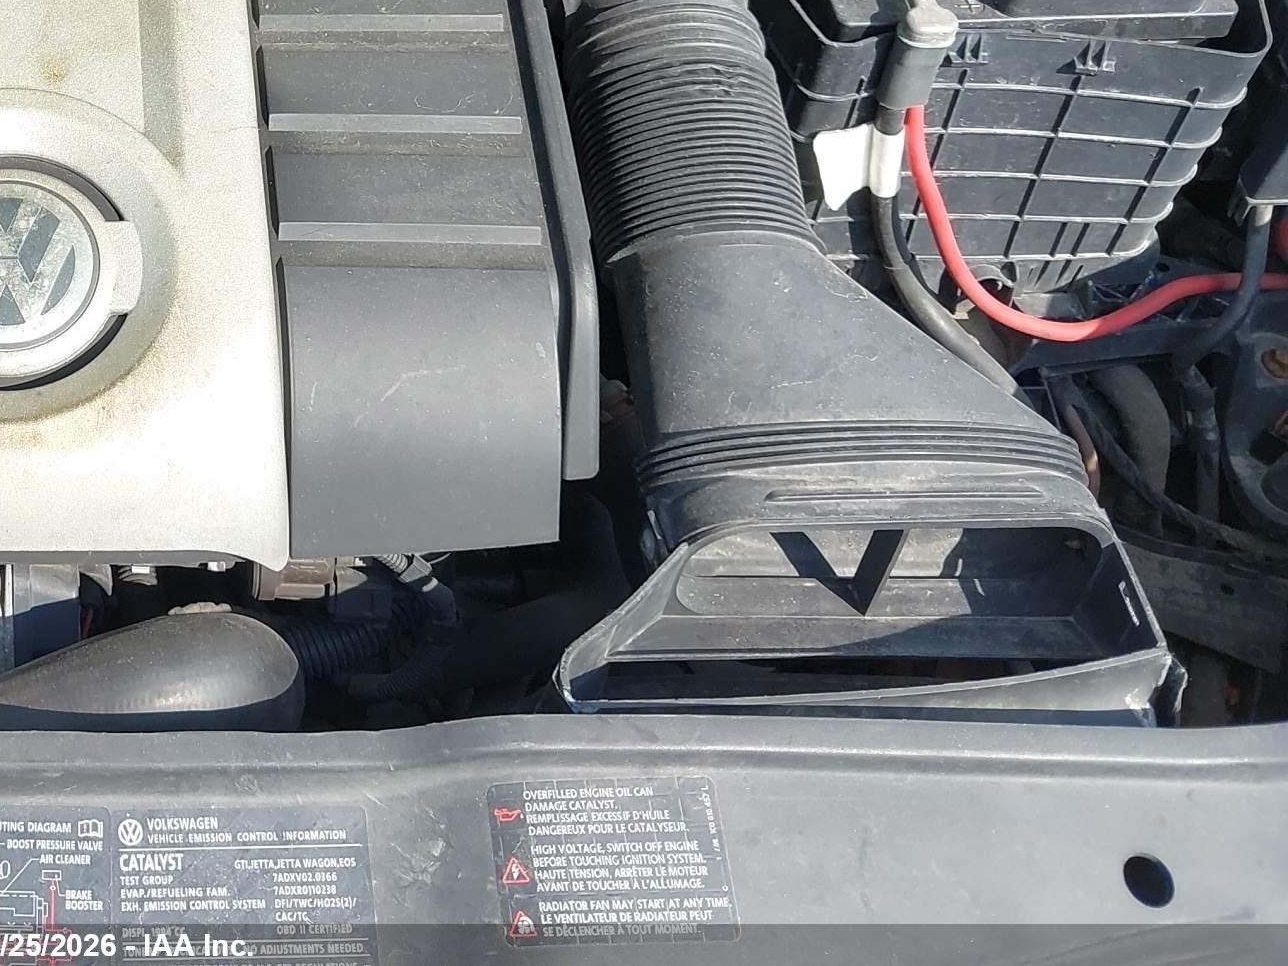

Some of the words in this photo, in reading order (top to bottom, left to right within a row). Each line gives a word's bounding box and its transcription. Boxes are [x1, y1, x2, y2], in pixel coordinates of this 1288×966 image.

[522, 788, 578, 801] OVERFILLED
[579, 787, 614, 799] ENGINE
[615, 787, 633, 797] OIL
[634, 786, 654, 797] CAN
[525, 800, 568, 812] DAMAGE
[568, 799, 618, 811] CATALYST.
[526, 812, 589, 824] REMPLISSAGE
[591, 810, 631, 822] EXCESSIF
[633, 809, 670, 821] D'HUILE
[27, 821, 72, 834] DIAGRAM
[146, 817, 219, 831] VOLKSWAGEN
[528, 824, 586, 836] DANGEREUX
[588, 823, 614, 835] POUR
[615, 823, 626, 833] LE
[627, 822, 690, 833] CATALYSEUR.
[147, 833, 184, 844] VEHICLE
[188, 832, 233, 843] EMISSION
[236, 831, 279, 842] CONTROL
[282, 829, 347, 841] INFORMATION
[6, 839, 35, 850] BOOST
[36, 839, 76, 851] PRESSURE
[77, 840, 104, 851] VALVE
[530, 844, 556, 856] HIGH
[557, 843, 605, 855] VOLTAGE,
[606, 842, 643, 853] SWITCH
[644, 841, 664, 852] OFF
[664, 840, 700, 852] ENGINE
[39, 854, 59, 865] AIR
[60, 854, 91, 865] CLEANER
[119, 853, 184, 872] CATALYST
[532, 856, 568, 868] BEFORE
[568, 855, 619, 867] TOUCHING
[621, 854, 666, 865] IGNITION
[667, 853, 707, 864] SYSTEM.
[534, 869, 567, 880] HAUTE
[568, 868, 613, 880] TENSION,
[614, 865, 654, 878] ARRÊTER
[655, 866, 667, 877] LE
[668, 865, 709, 877] MOTEUR
[119, 875, 140, 886] TEST
[142, 874, 174, 886] GROUP
[536, 881, 570, 892] AVANT
[572, 880, 586, 891] DE
[586, 879, 630, 891] TOUCHER
[632, 878, 641, 890] À
[642, 878, 705, 890] L'ALLUMAGE.
[65, 890, 92, 900] BRAKE
[120, 887, 203, 899] EVAP./REFUELING
[206, 886, 231, 897] FAM.
[65, 900, 104, 911] BOOSTER
[121, 901, 142, 912] EXH.
[144, 900, 187, 912] EMISSION
[189, 899, 230, 911] CONTROL
[232, 899, 266, 910] SYSTEM
[538, 900, 589, 912] RADIATOR
[590, 900, 610, 911] FAN
[612, 899, 634, 910] MAY
[636, 898, 666, 909] START
[668, 898, 681, 909] AT
[683, 897, 703, 909] ANY
[705, 897, 732, 907] TIME.
[275, 911, 309, 922] CAC/TC
[540, 913, 553, 924] LE
[553, 912, 618, 924] VENTILATEUR
[619, 912, 632, 923] DE
[633, 911, 688, 922] RADIATEUR
[689, 910, 713, 921] PEUT
[276, 924, 296, 935] OBD
[300, 924, 306, 934] II
[308, 923, 353, 934] CERTIFIED
[543, 926, 554, 937] SE
[556, 924, 616, 937] DÉCLENCHER
[617, 923, 625, 935] À
[626, 924, 652, 935] TOUT
[654, 923, 702, 935] MOMENT.
[260, 943, 325, 955] ADJUSTMENTS
[327, 942, 364, 954] NEEDED
